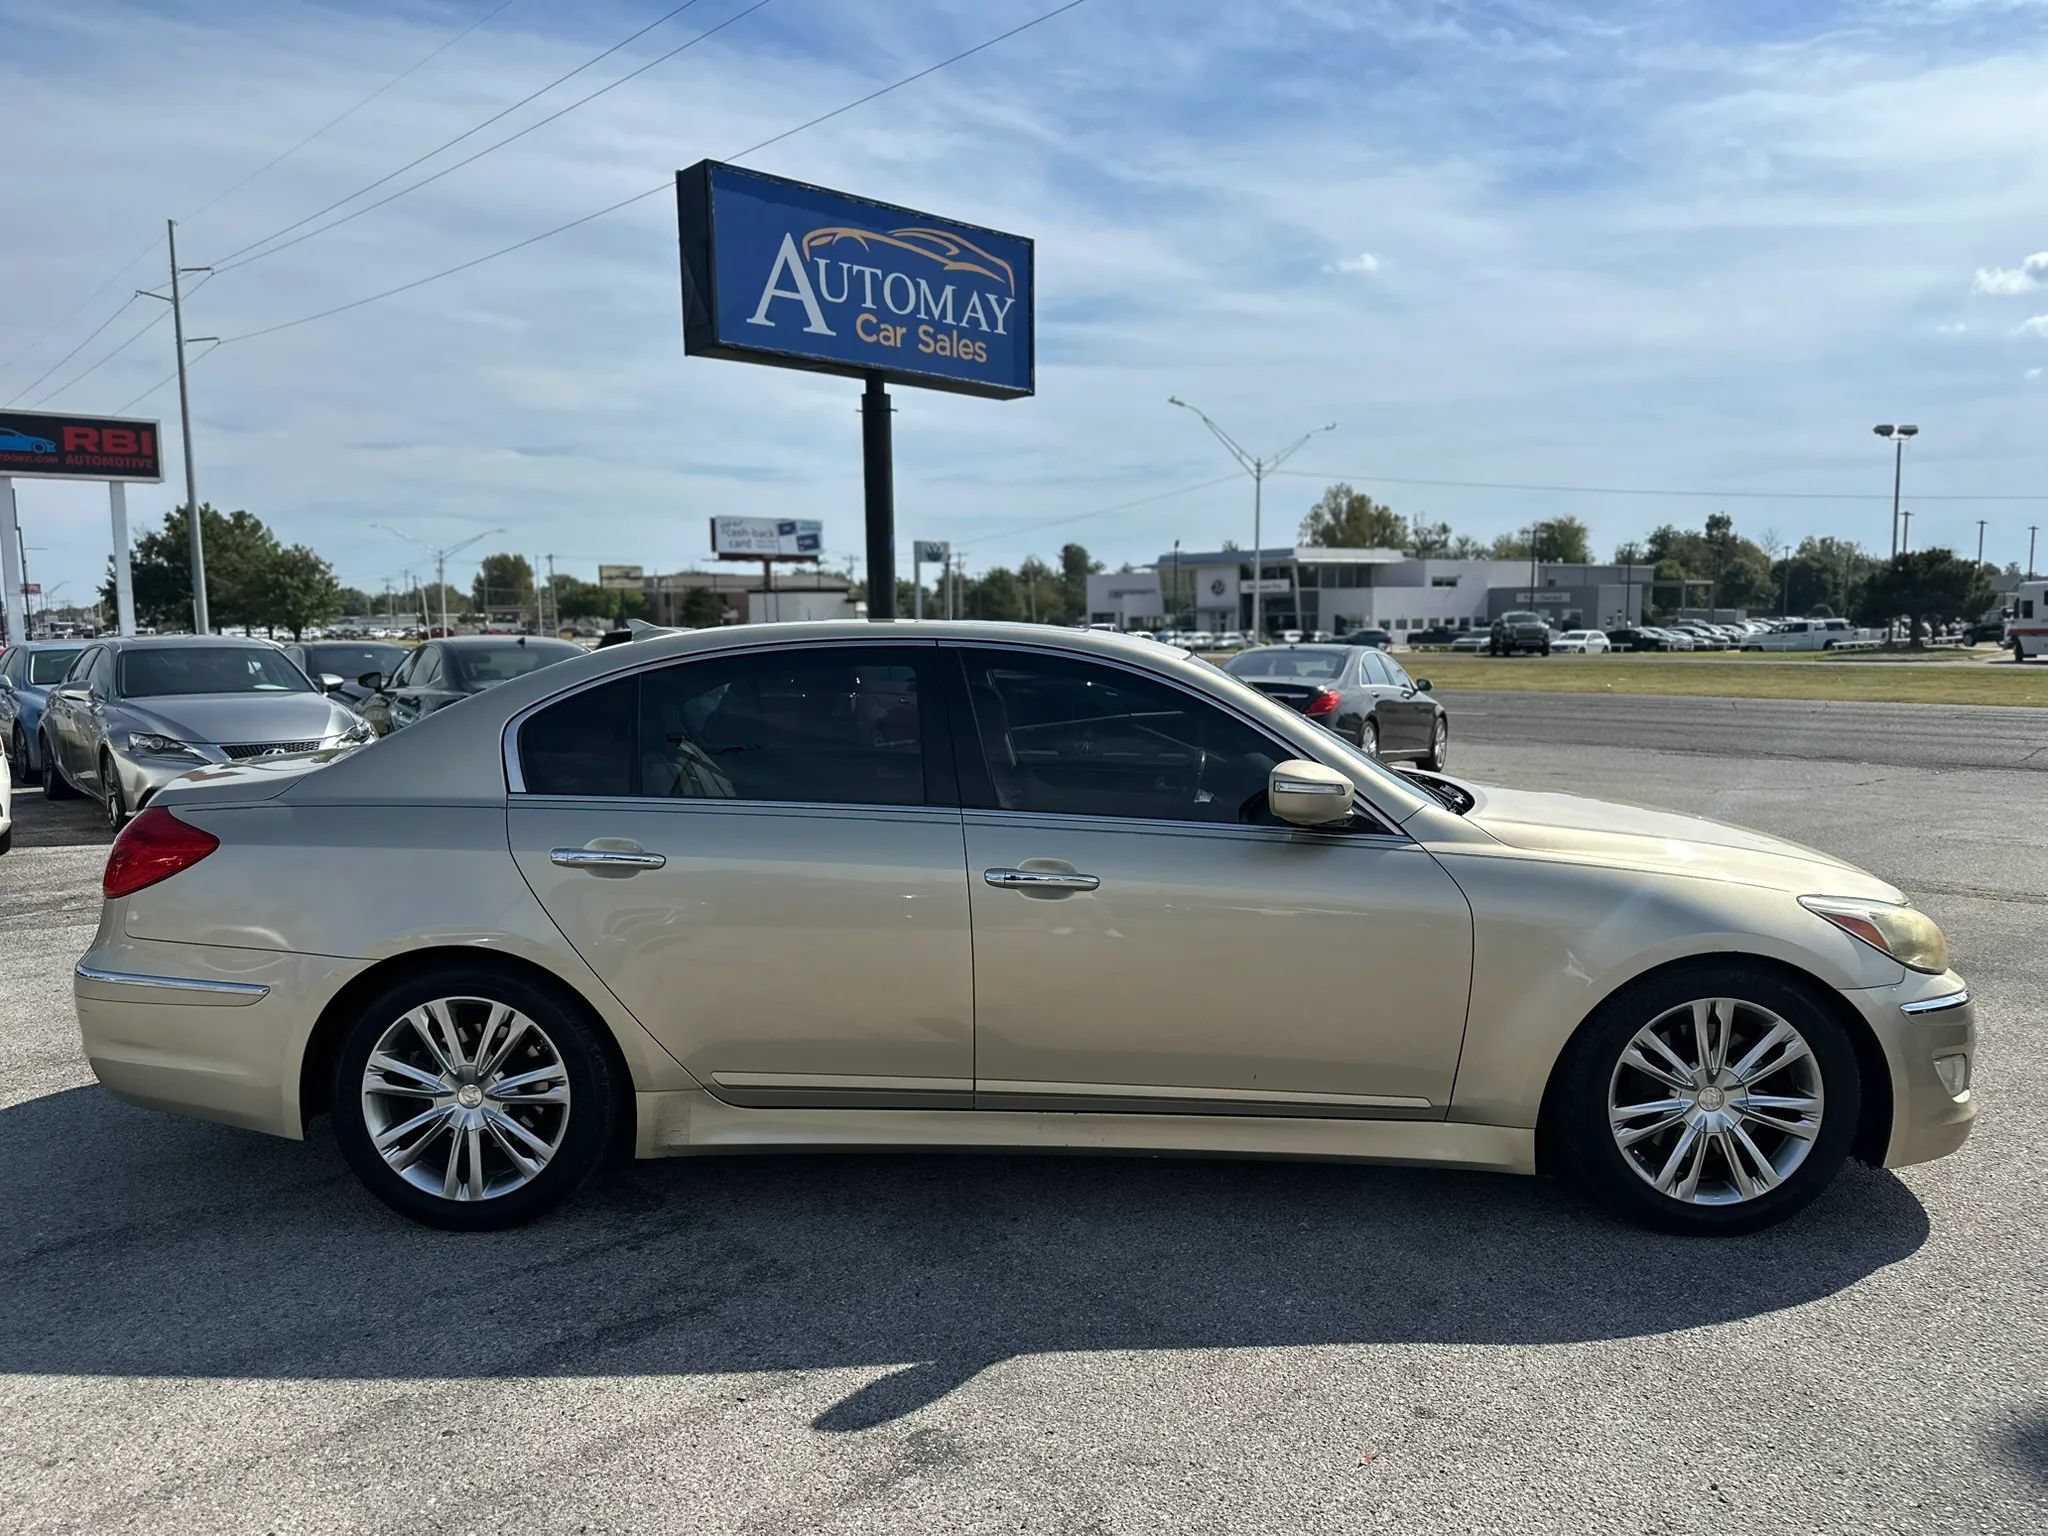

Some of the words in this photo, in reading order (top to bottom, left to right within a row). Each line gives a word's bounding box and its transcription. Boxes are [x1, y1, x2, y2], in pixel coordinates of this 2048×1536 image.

[746, 232, 1015, 336] AUTOMAY
[855, 313, 907, 347] Car
[917, 325, 988, 363] Sales
[64, 426, 153, 456] RBI
[65, 455, 153, 469] AUTOMOTIVE
